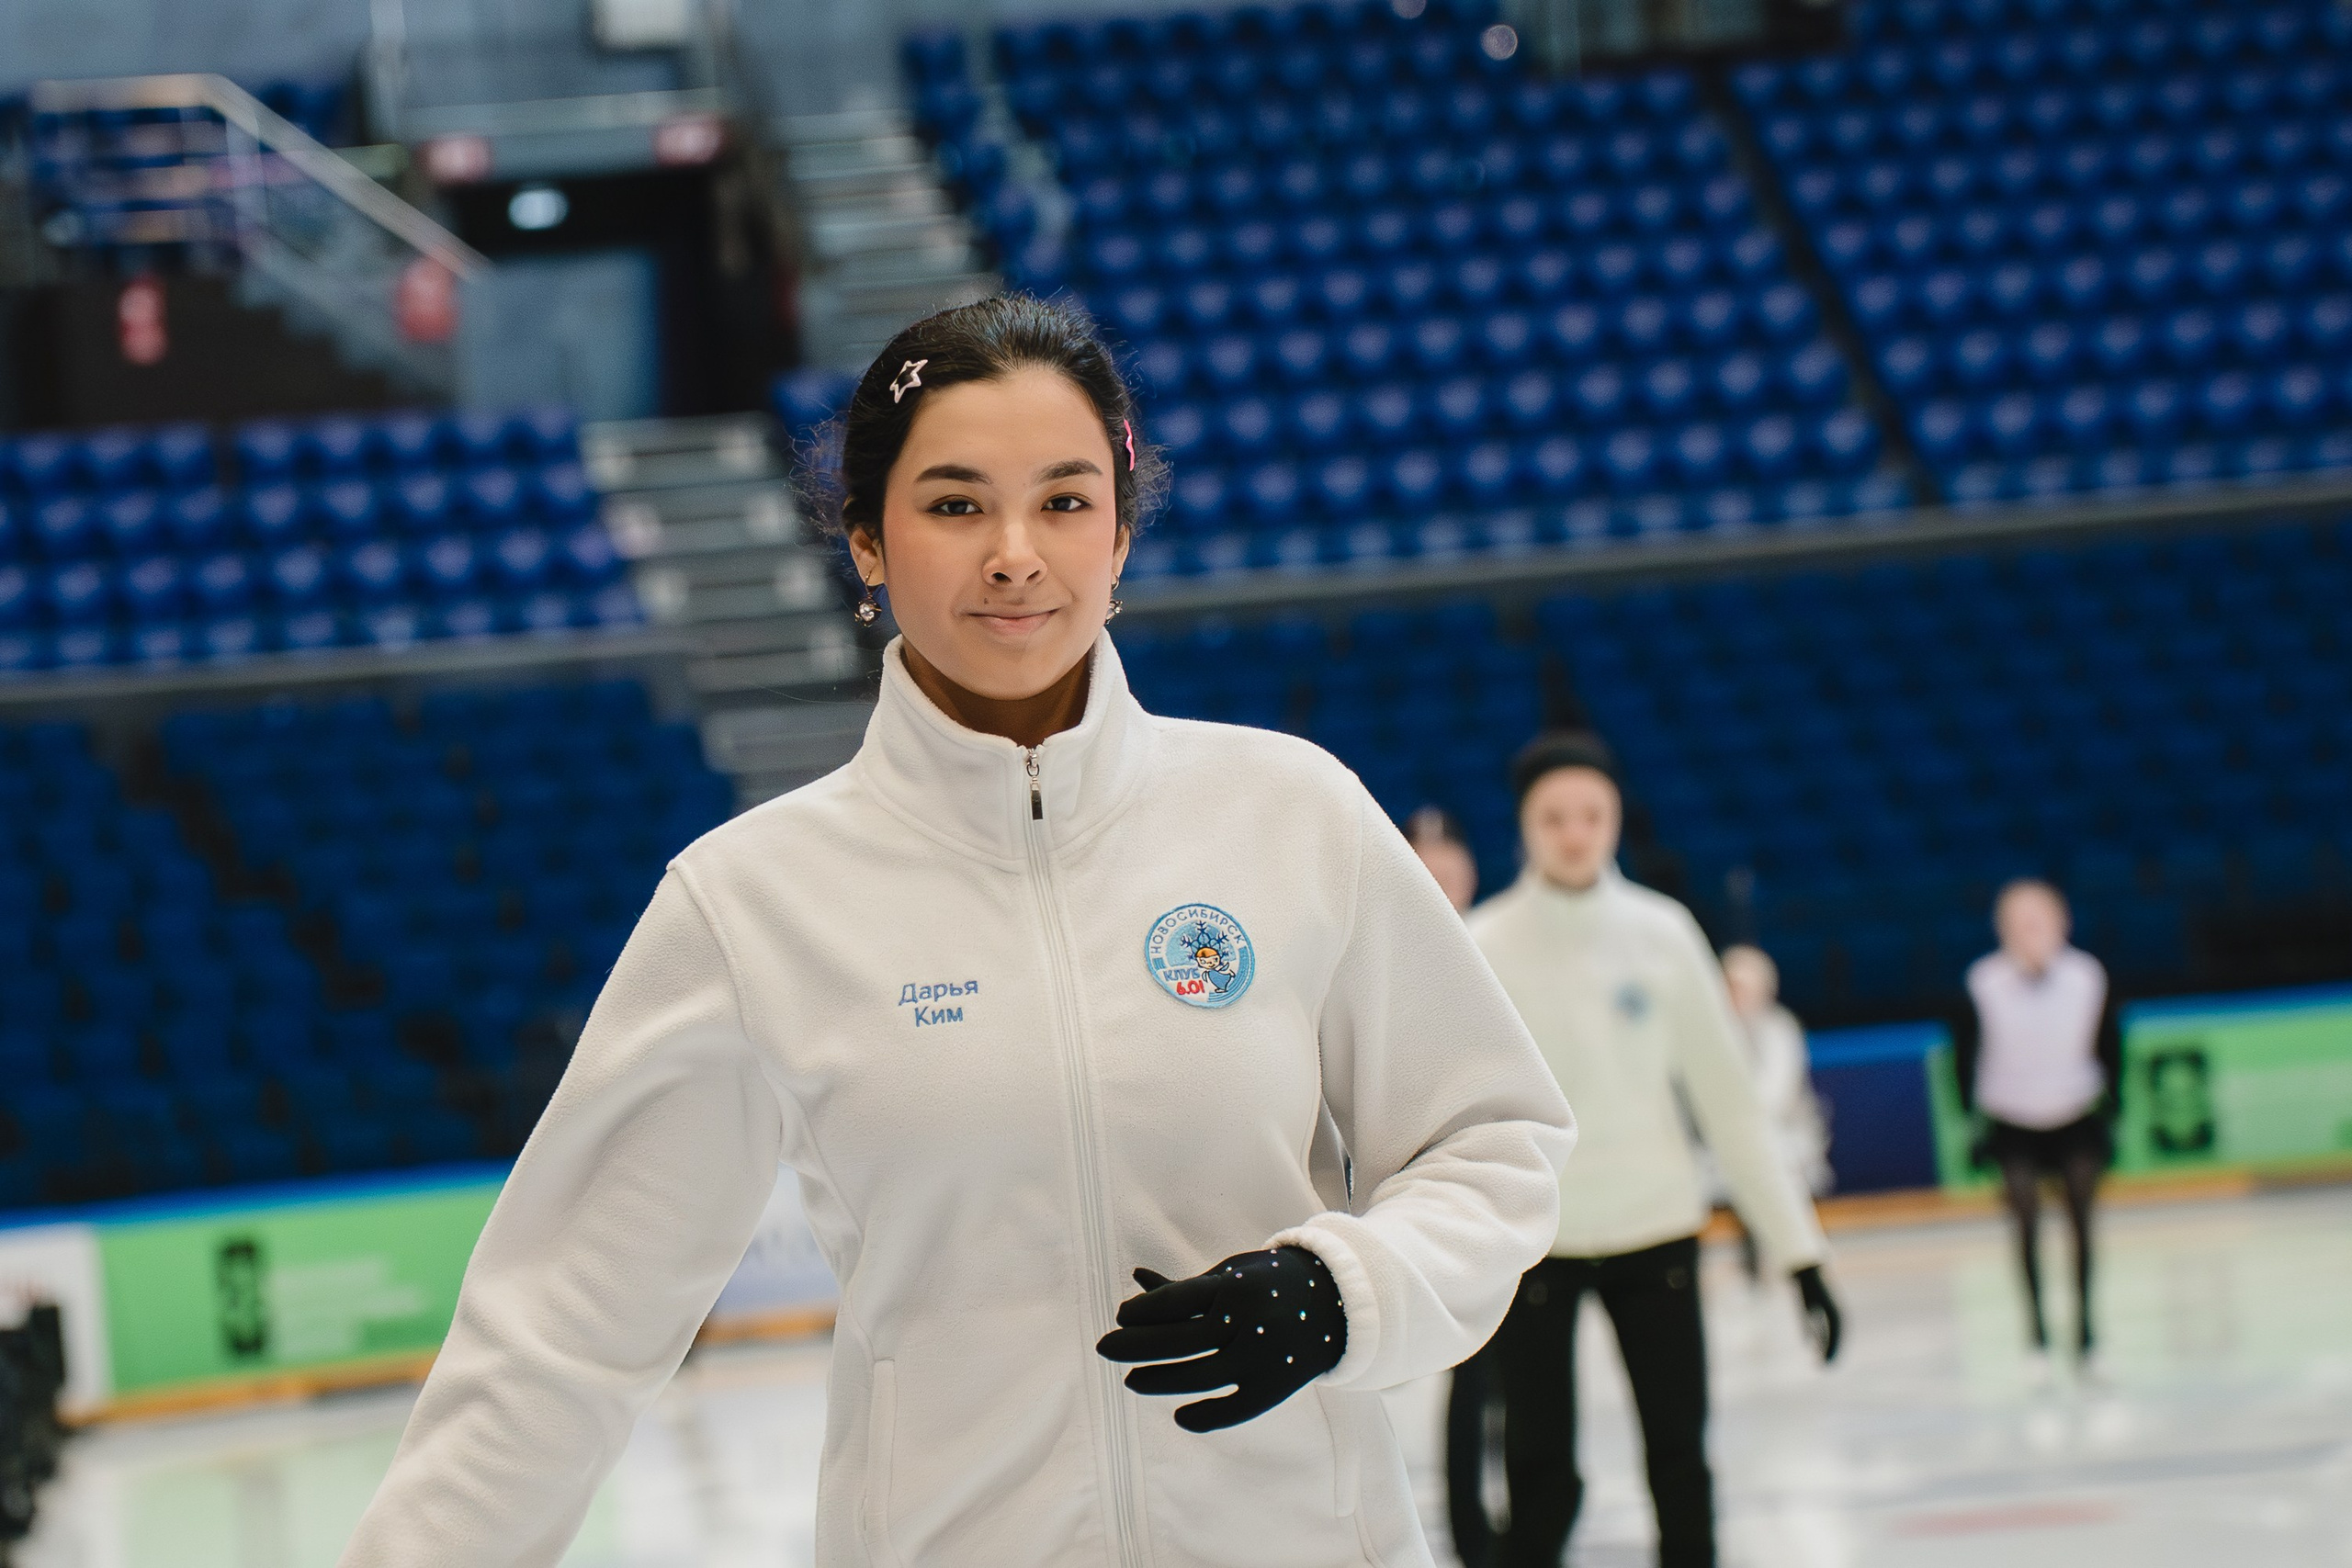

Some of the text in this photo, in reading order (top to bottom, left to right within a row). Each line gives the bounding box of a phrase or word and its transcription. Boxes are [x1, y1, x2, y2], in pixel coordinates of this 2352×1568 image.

[1150, 908, 1246, 954] НОВОСИБИРСК
[1162, 967, 1201, 981] КЛУБ
[898, 980, 978, 1006] Дарья
[914, 1006, 963, 1027] Ким
